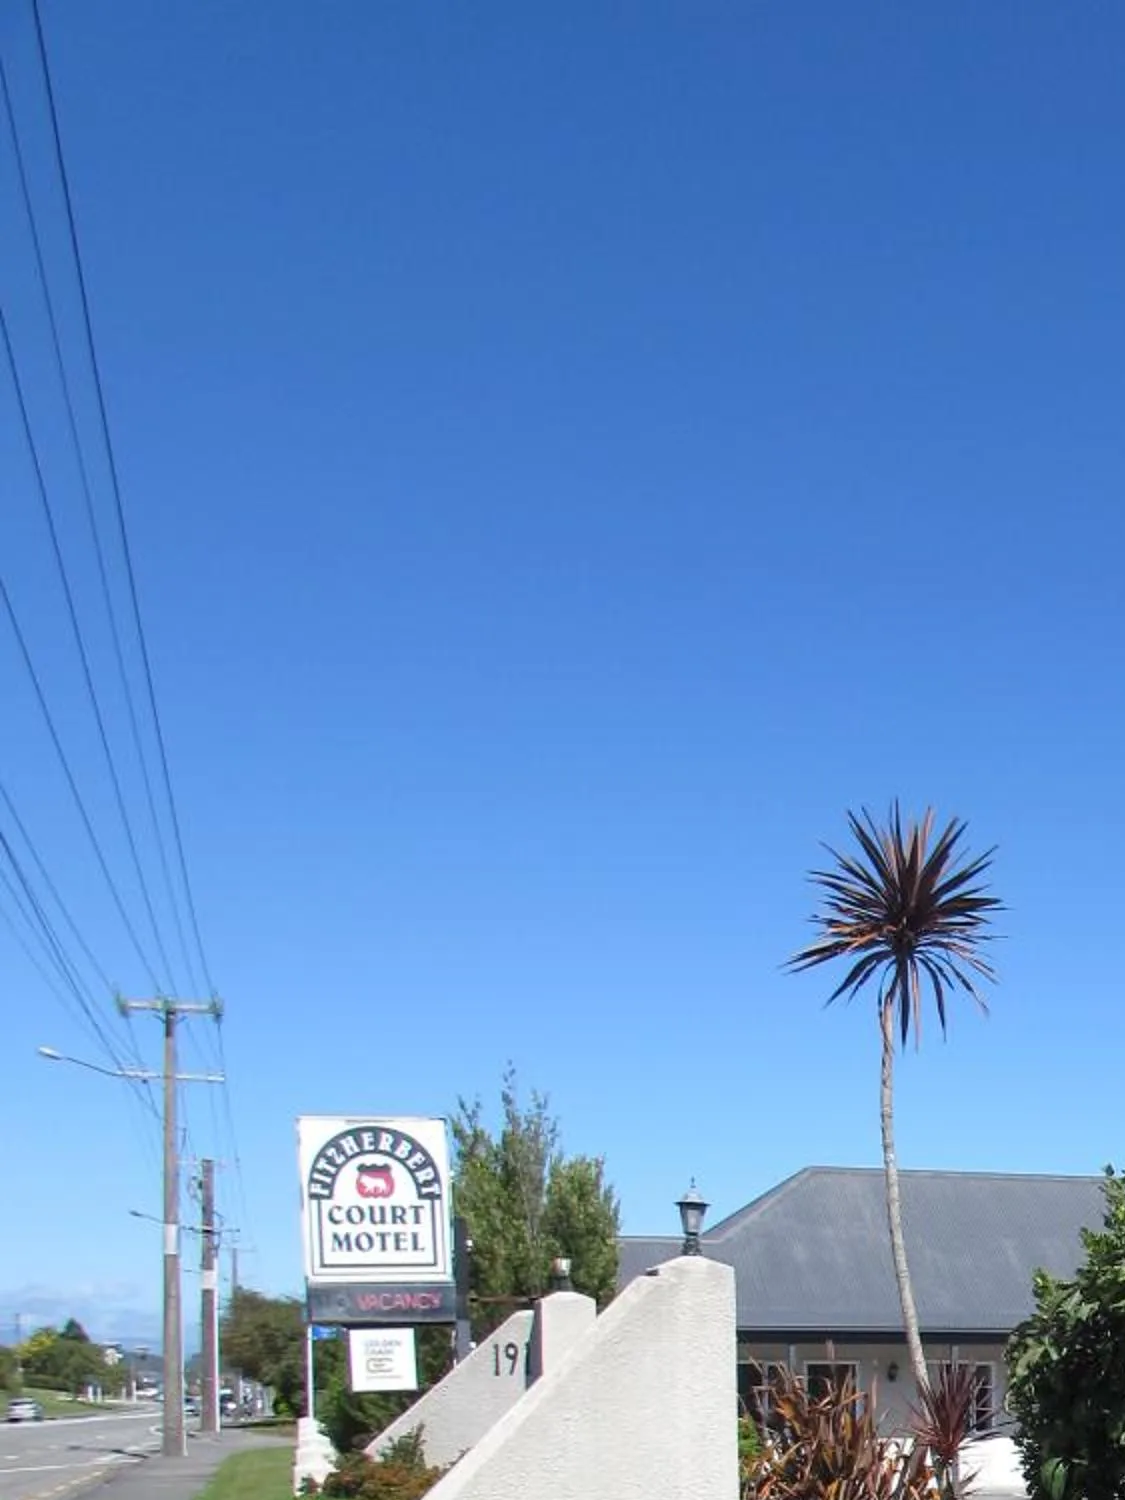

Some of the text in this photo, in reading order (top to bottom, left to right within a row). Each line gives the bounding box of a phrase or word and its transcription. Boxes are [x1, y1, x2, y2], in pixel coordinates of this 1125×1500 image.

[309, 1131, 440, 1196] FITZHERBERT
[328, 1205, 425, 1226] COURT
[331, 1231, 425, 1252] MOTEL
[356, 1291, 442, 1311] VACANCY
